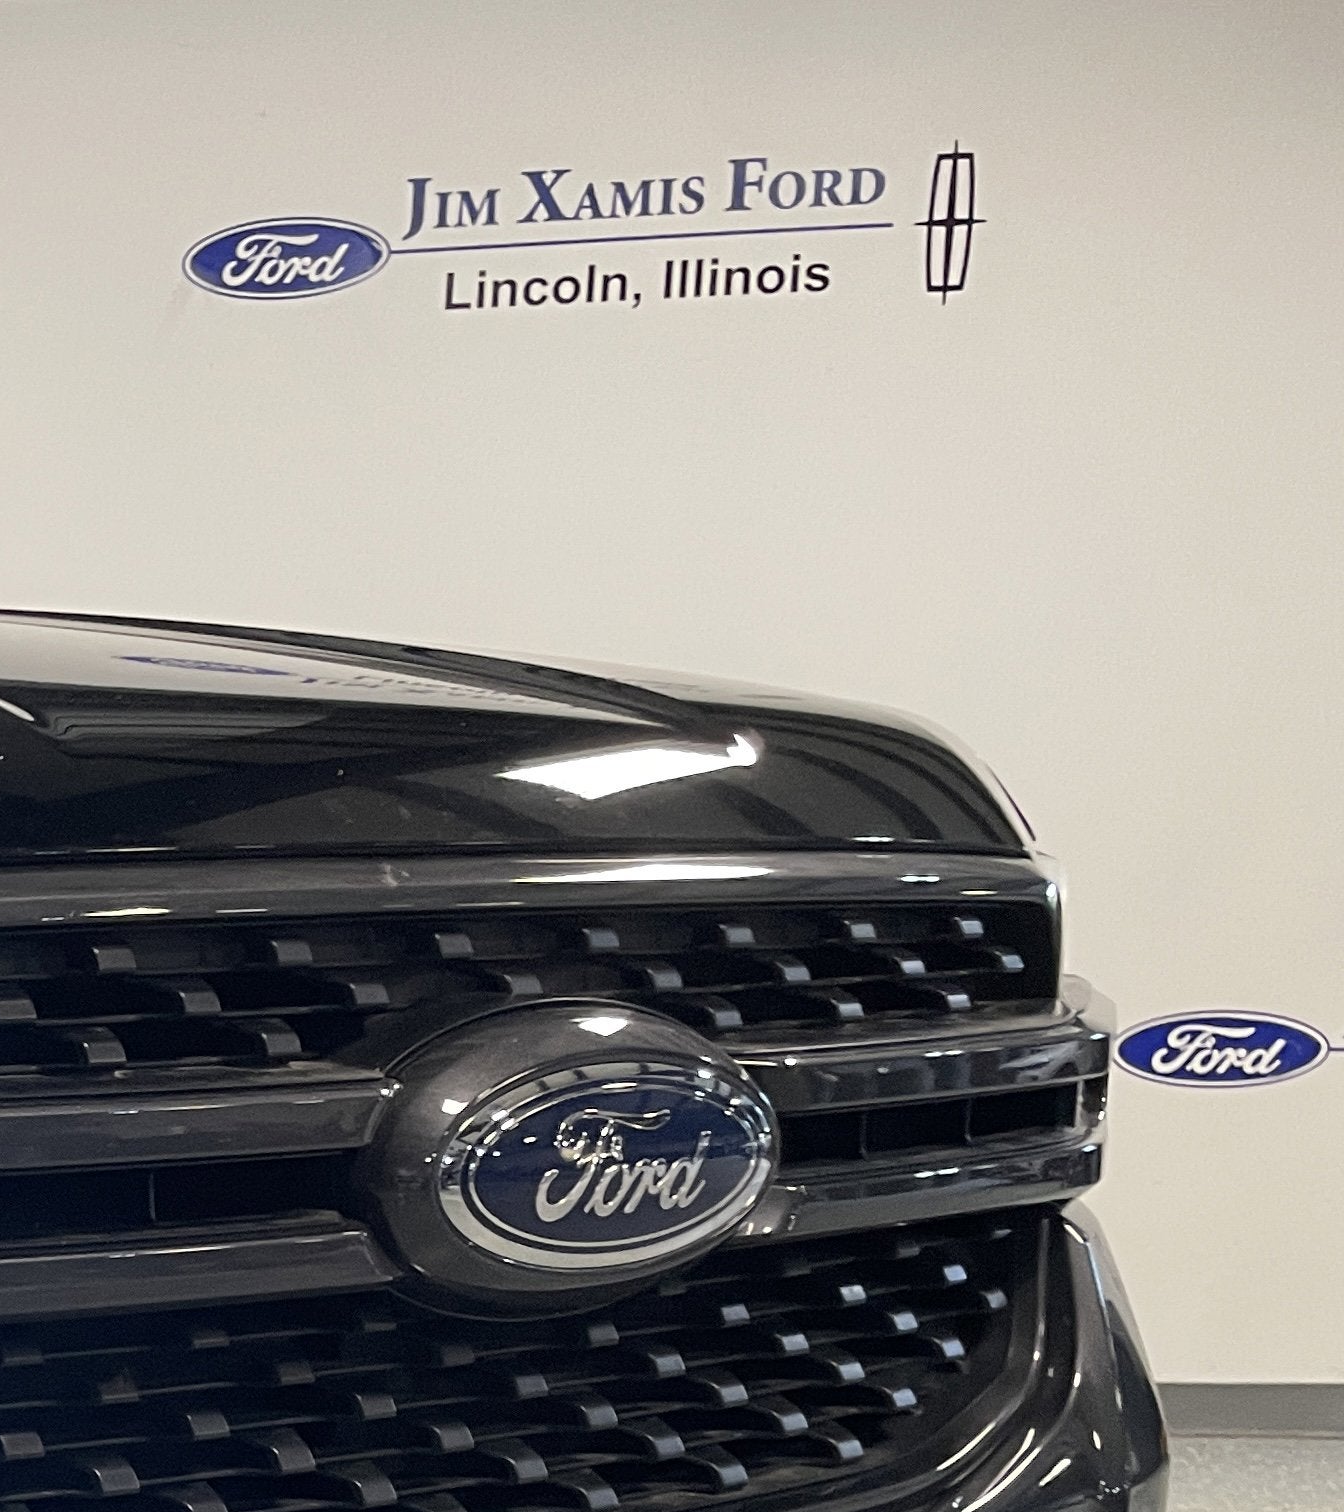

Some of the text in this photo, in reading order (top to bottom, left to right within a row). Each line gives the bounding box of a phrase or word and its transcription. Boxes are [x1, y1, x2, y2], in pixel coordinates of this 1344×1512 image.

[401, 157, 886, 241] JIM XAMIS FORD
[221, 233, 349, 287] Ford
[445, 253, 831, 310] Lincoln, Illinois
[1150, 1023, 1288, 1076] Ford
[534, 1106, 712, 1222] Ford
